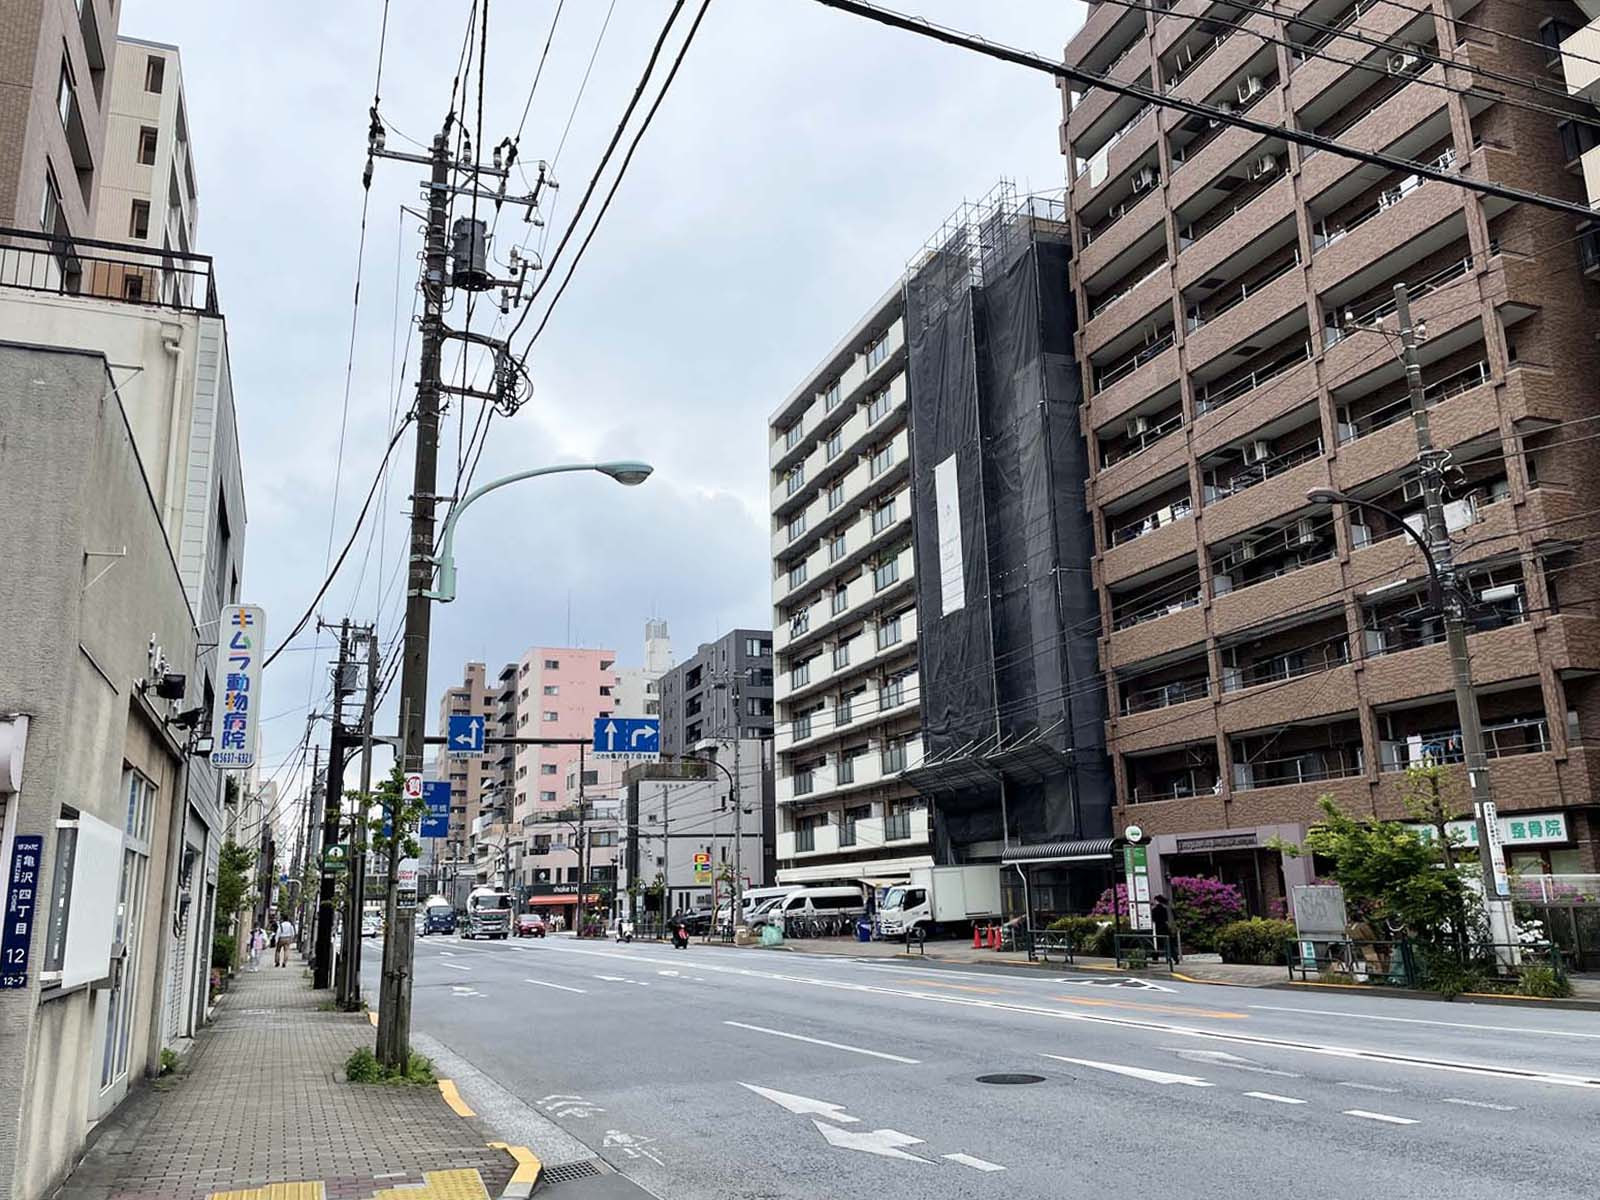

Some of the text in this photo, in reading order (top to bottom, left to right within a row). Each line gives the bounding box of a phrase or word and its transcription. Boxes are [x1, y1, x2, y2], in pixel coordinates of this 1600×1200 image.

[222, 608, 253, 750] キムラ動物病院
[1510, 820, 1562, 839] 整骨院
[15, 855, 35, 935] 亀沢四丁目
[7, 948, 25, 964] 12
[3, 976, 25, 986] 12-7
